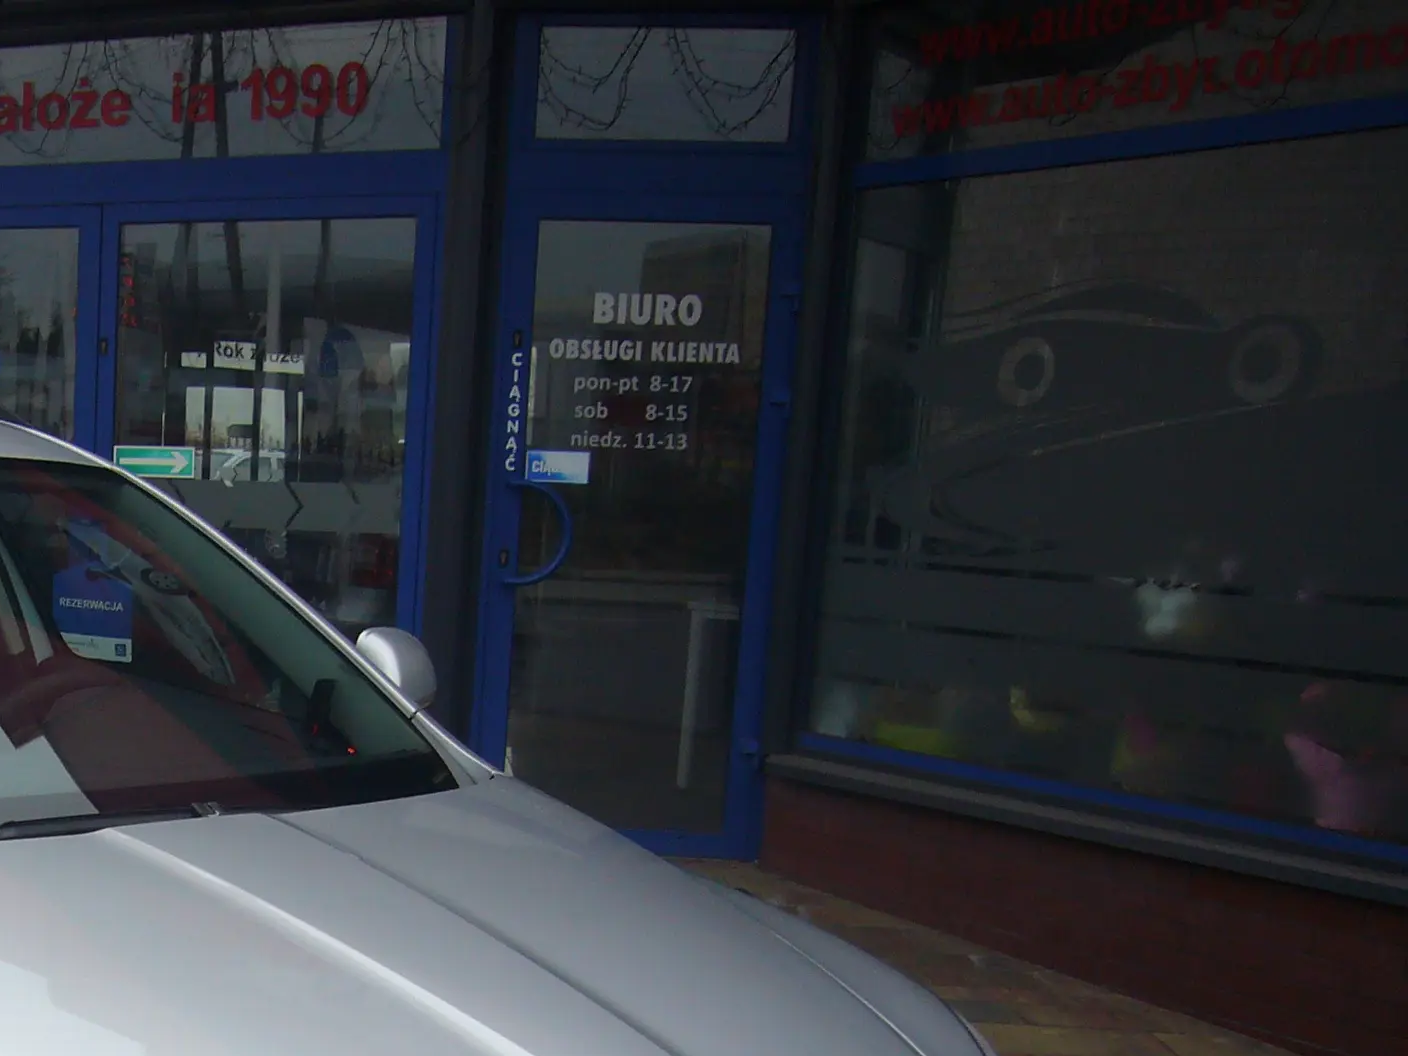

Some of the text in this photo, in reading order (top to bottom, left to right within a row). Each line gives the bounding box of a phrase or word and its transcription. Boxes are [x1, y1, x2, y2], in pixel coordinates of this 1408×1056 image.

[241, 61, 370, 121] 1990
[592, 292, 703, 326] BIURO
[549, 338, 740, 364] OBSŁUGI KLIENTA
[573, 375, 693, 395] pon-pt 8-17
[574, 401, 688, 421] sob 8-15
[570, 430, 688, 450] niedz. 11-13
[59, 596, 124, 612] REZERWACJA
